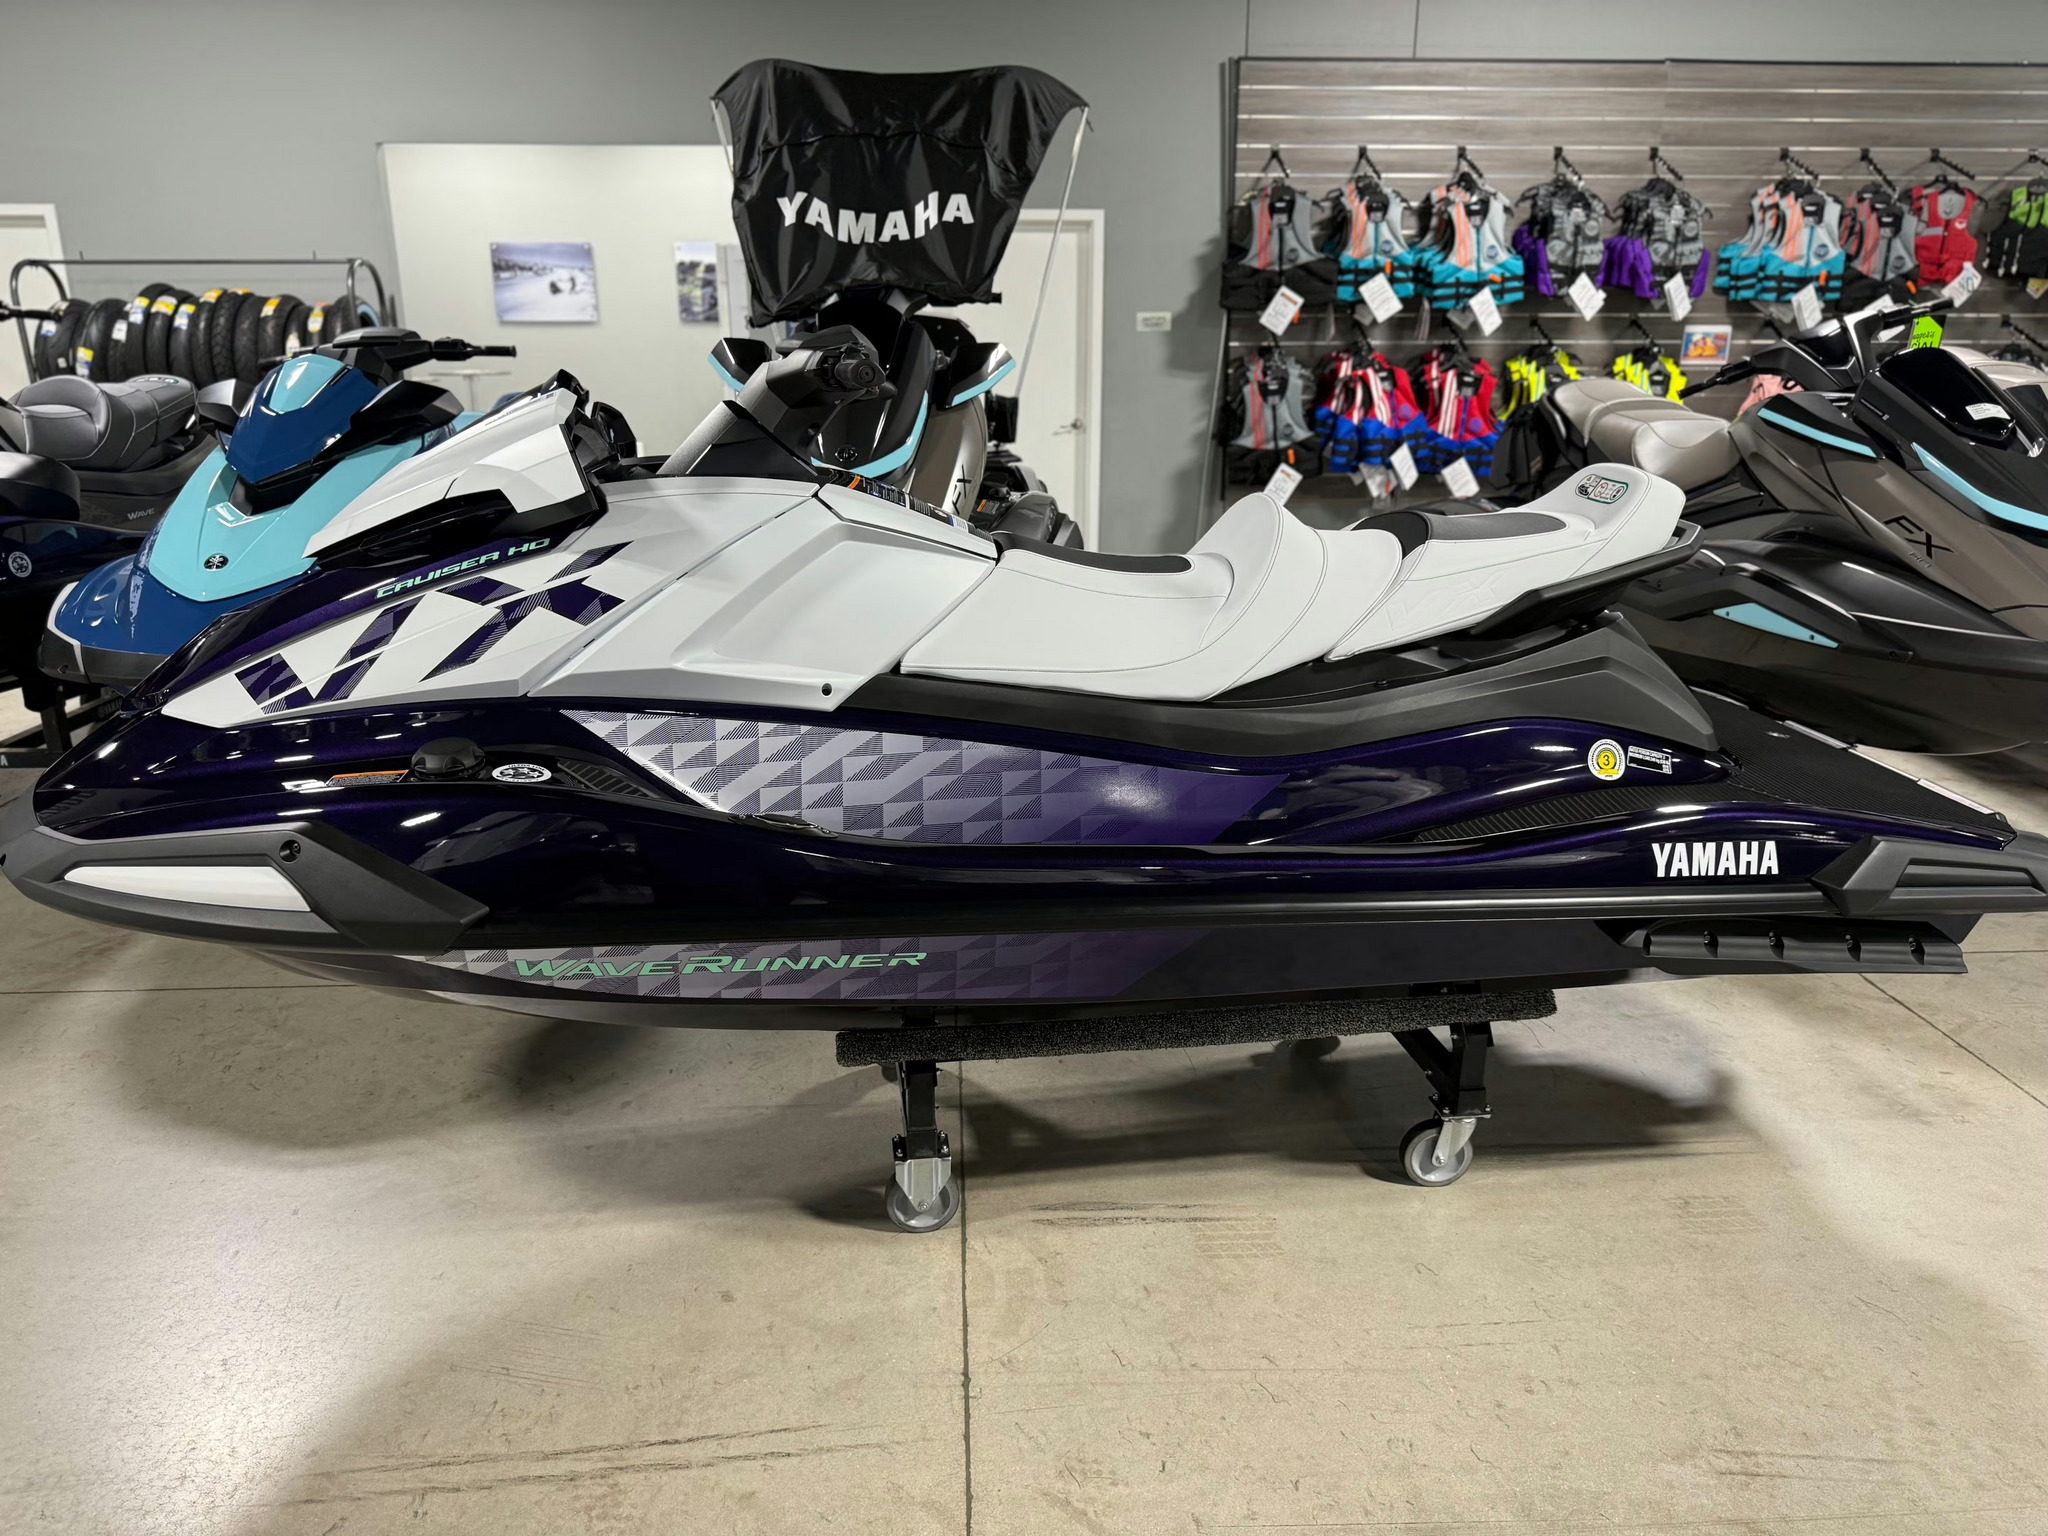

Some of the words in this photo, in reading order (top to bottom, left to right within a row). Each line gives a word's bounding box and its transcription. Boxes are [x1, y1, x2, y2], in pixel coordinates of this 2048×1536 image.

[776, 190, 975, 245] YAMAHA
[1883, 515, 1954, 559] FX
[376, 551, 501, 599] CRUISER
[1603, 754, 1610, 767] 3
[1651, 840, 1779, 878] YAMAHA
[514, 951, 928, 978] WAVERUNNER
